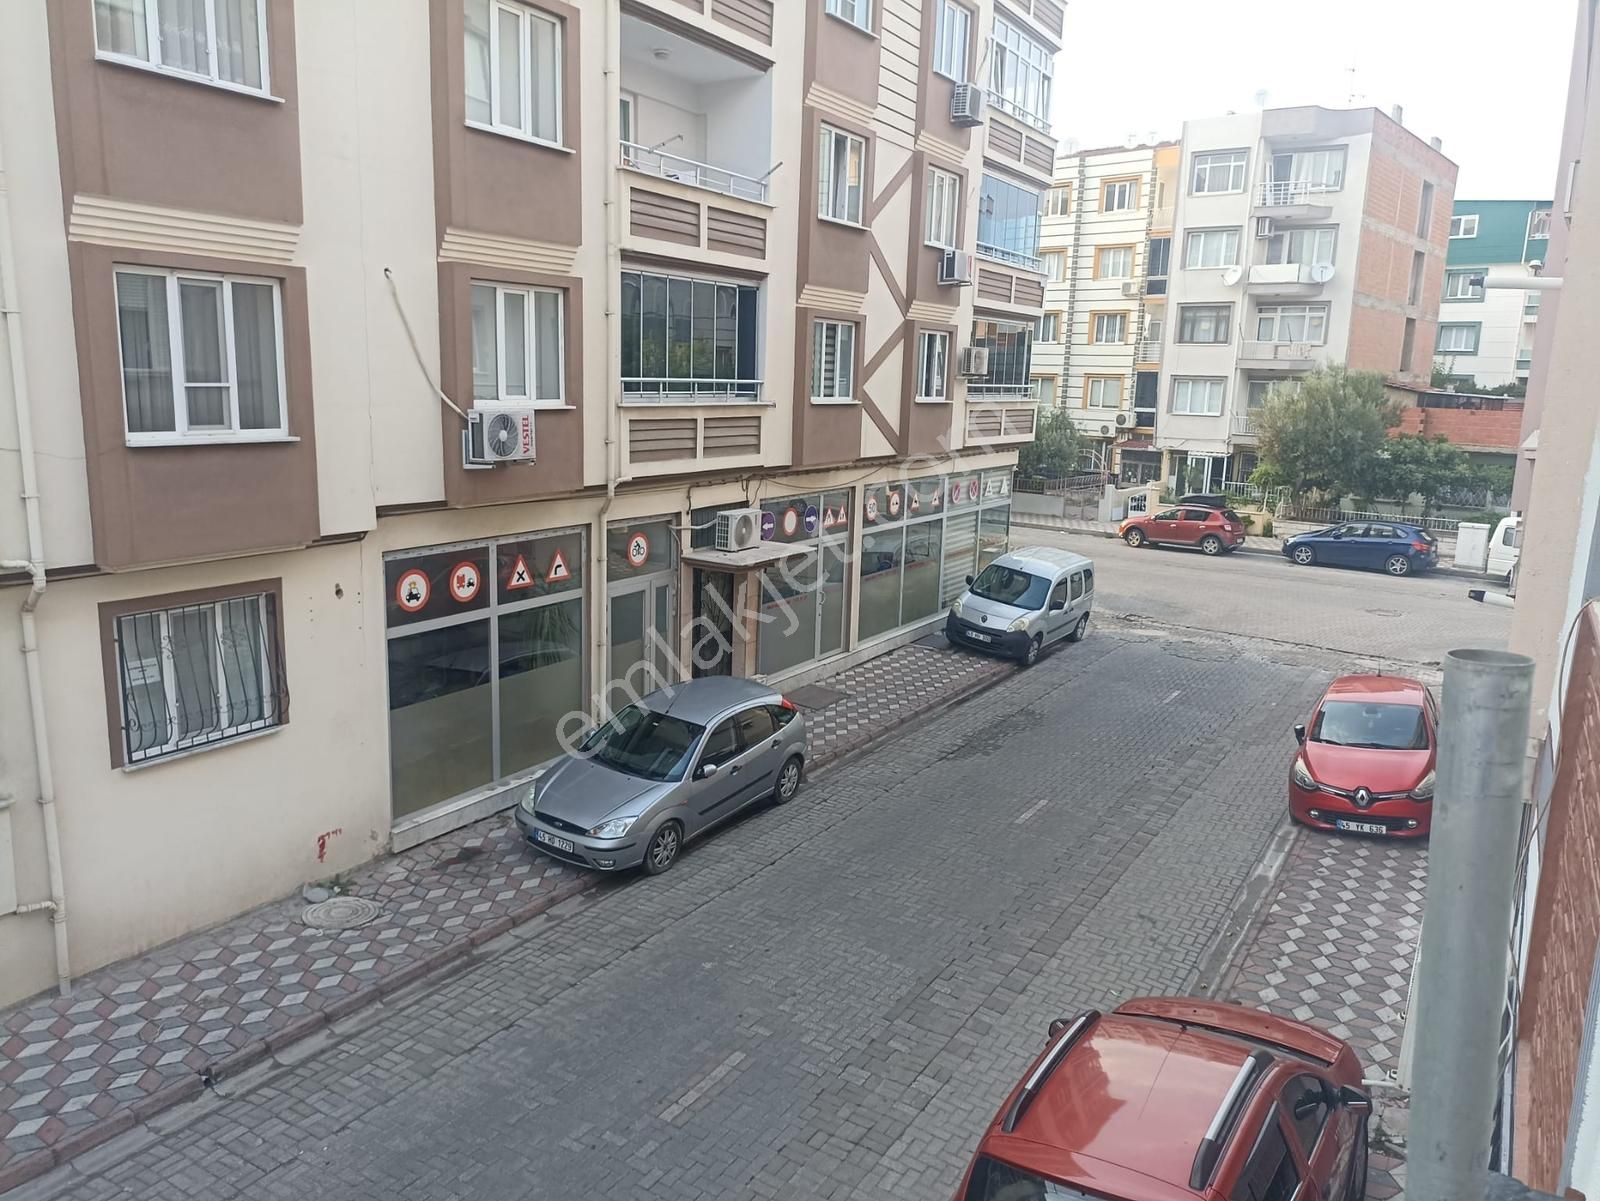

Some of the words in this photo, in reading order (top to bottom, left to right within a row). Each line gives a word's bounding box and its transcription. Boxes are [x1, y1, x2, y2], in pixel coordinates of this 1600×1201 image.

[522, 415, 530, 454] VESTEL
[868, 502, 876, 514] 50
[1356, 823, 1364, 831] YK
